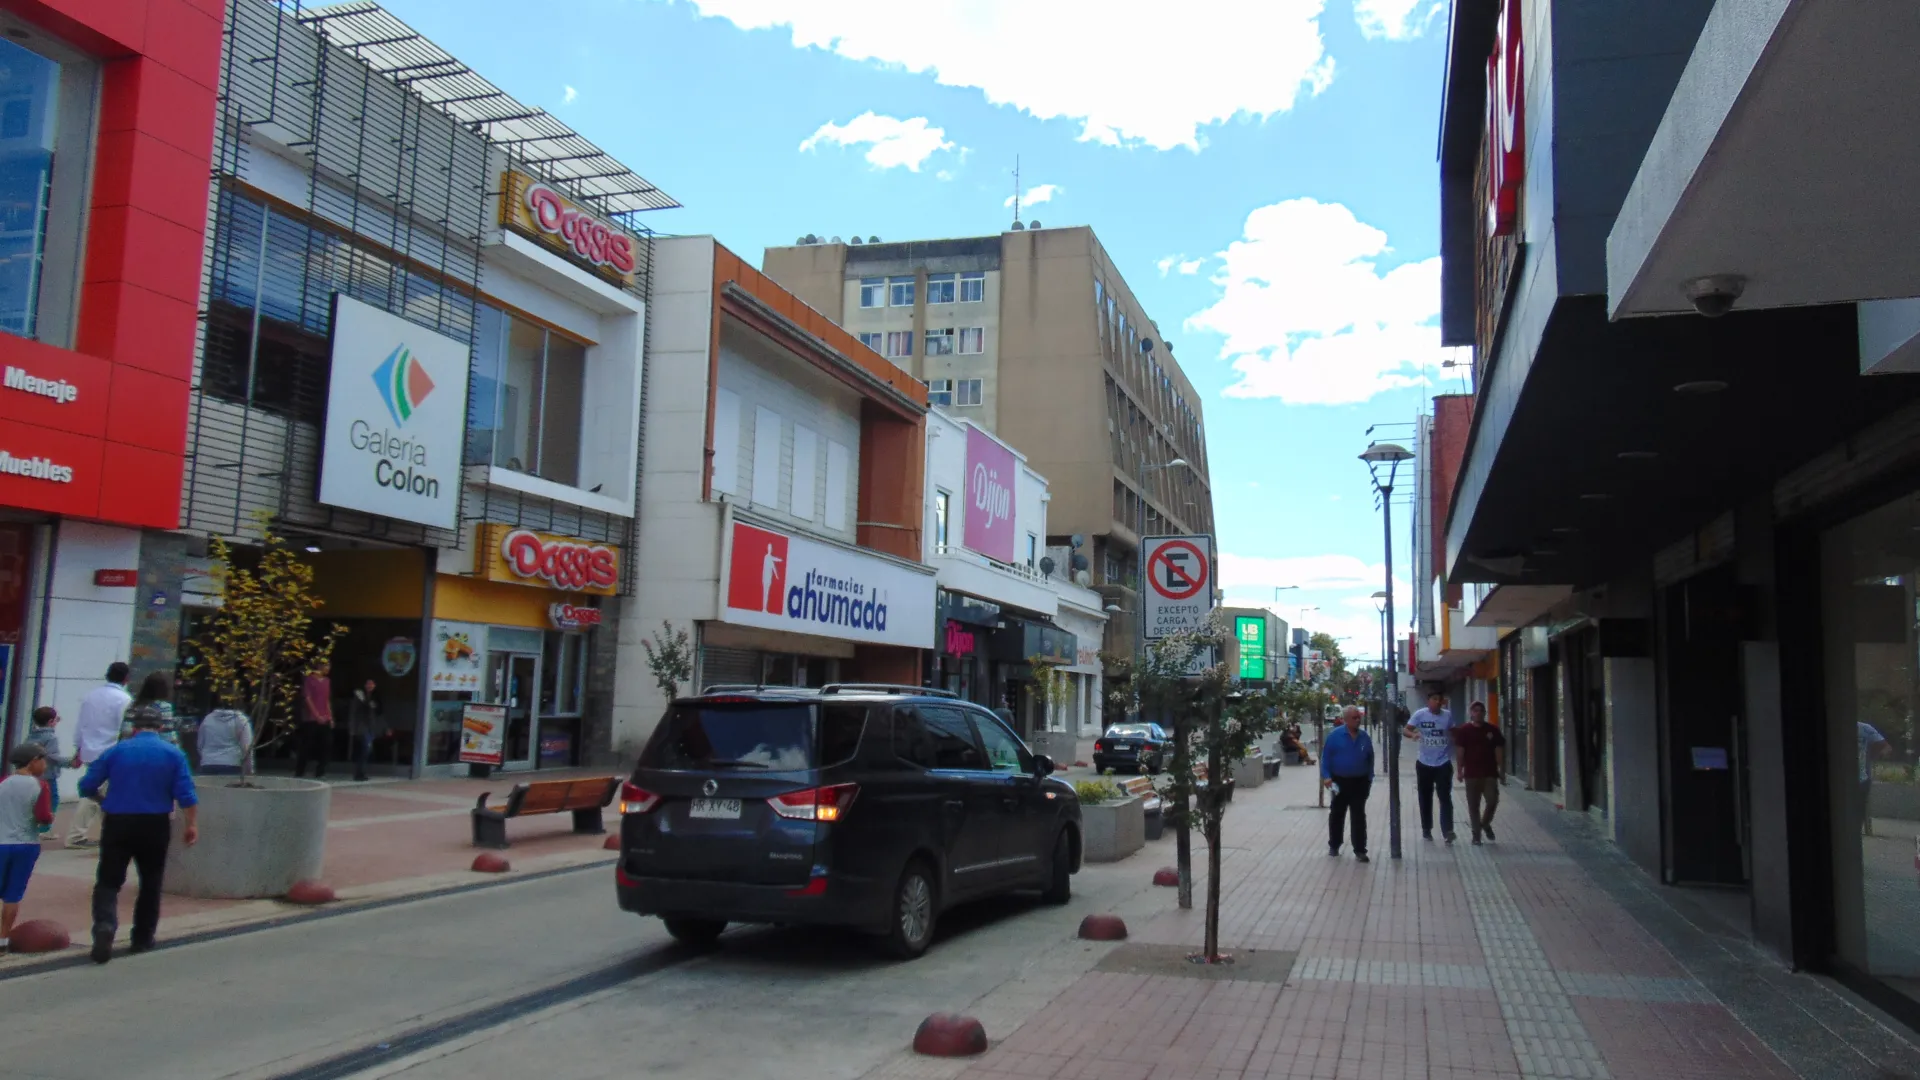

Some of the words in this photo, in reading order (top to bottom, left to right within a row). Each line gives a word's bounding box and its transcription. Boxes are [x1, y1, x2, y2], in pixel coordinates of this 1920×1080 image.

[3, 365, 78, 404] Menaje
[350, 420, 427, 467] Galeria
[376, 459, 439, 499] Colon
[973, 462, 1010, 529] Dijon
[811, 568, 864, 595] farmacias
[788, 572, 887, 632] ahumada
[1156, 616, 1187, 625] CARGA
[1192, 616, 1199, 625] Y
[1158, 605, 1199, 615] EXCEPTO
[945, 620, 974, 659] Dijon
